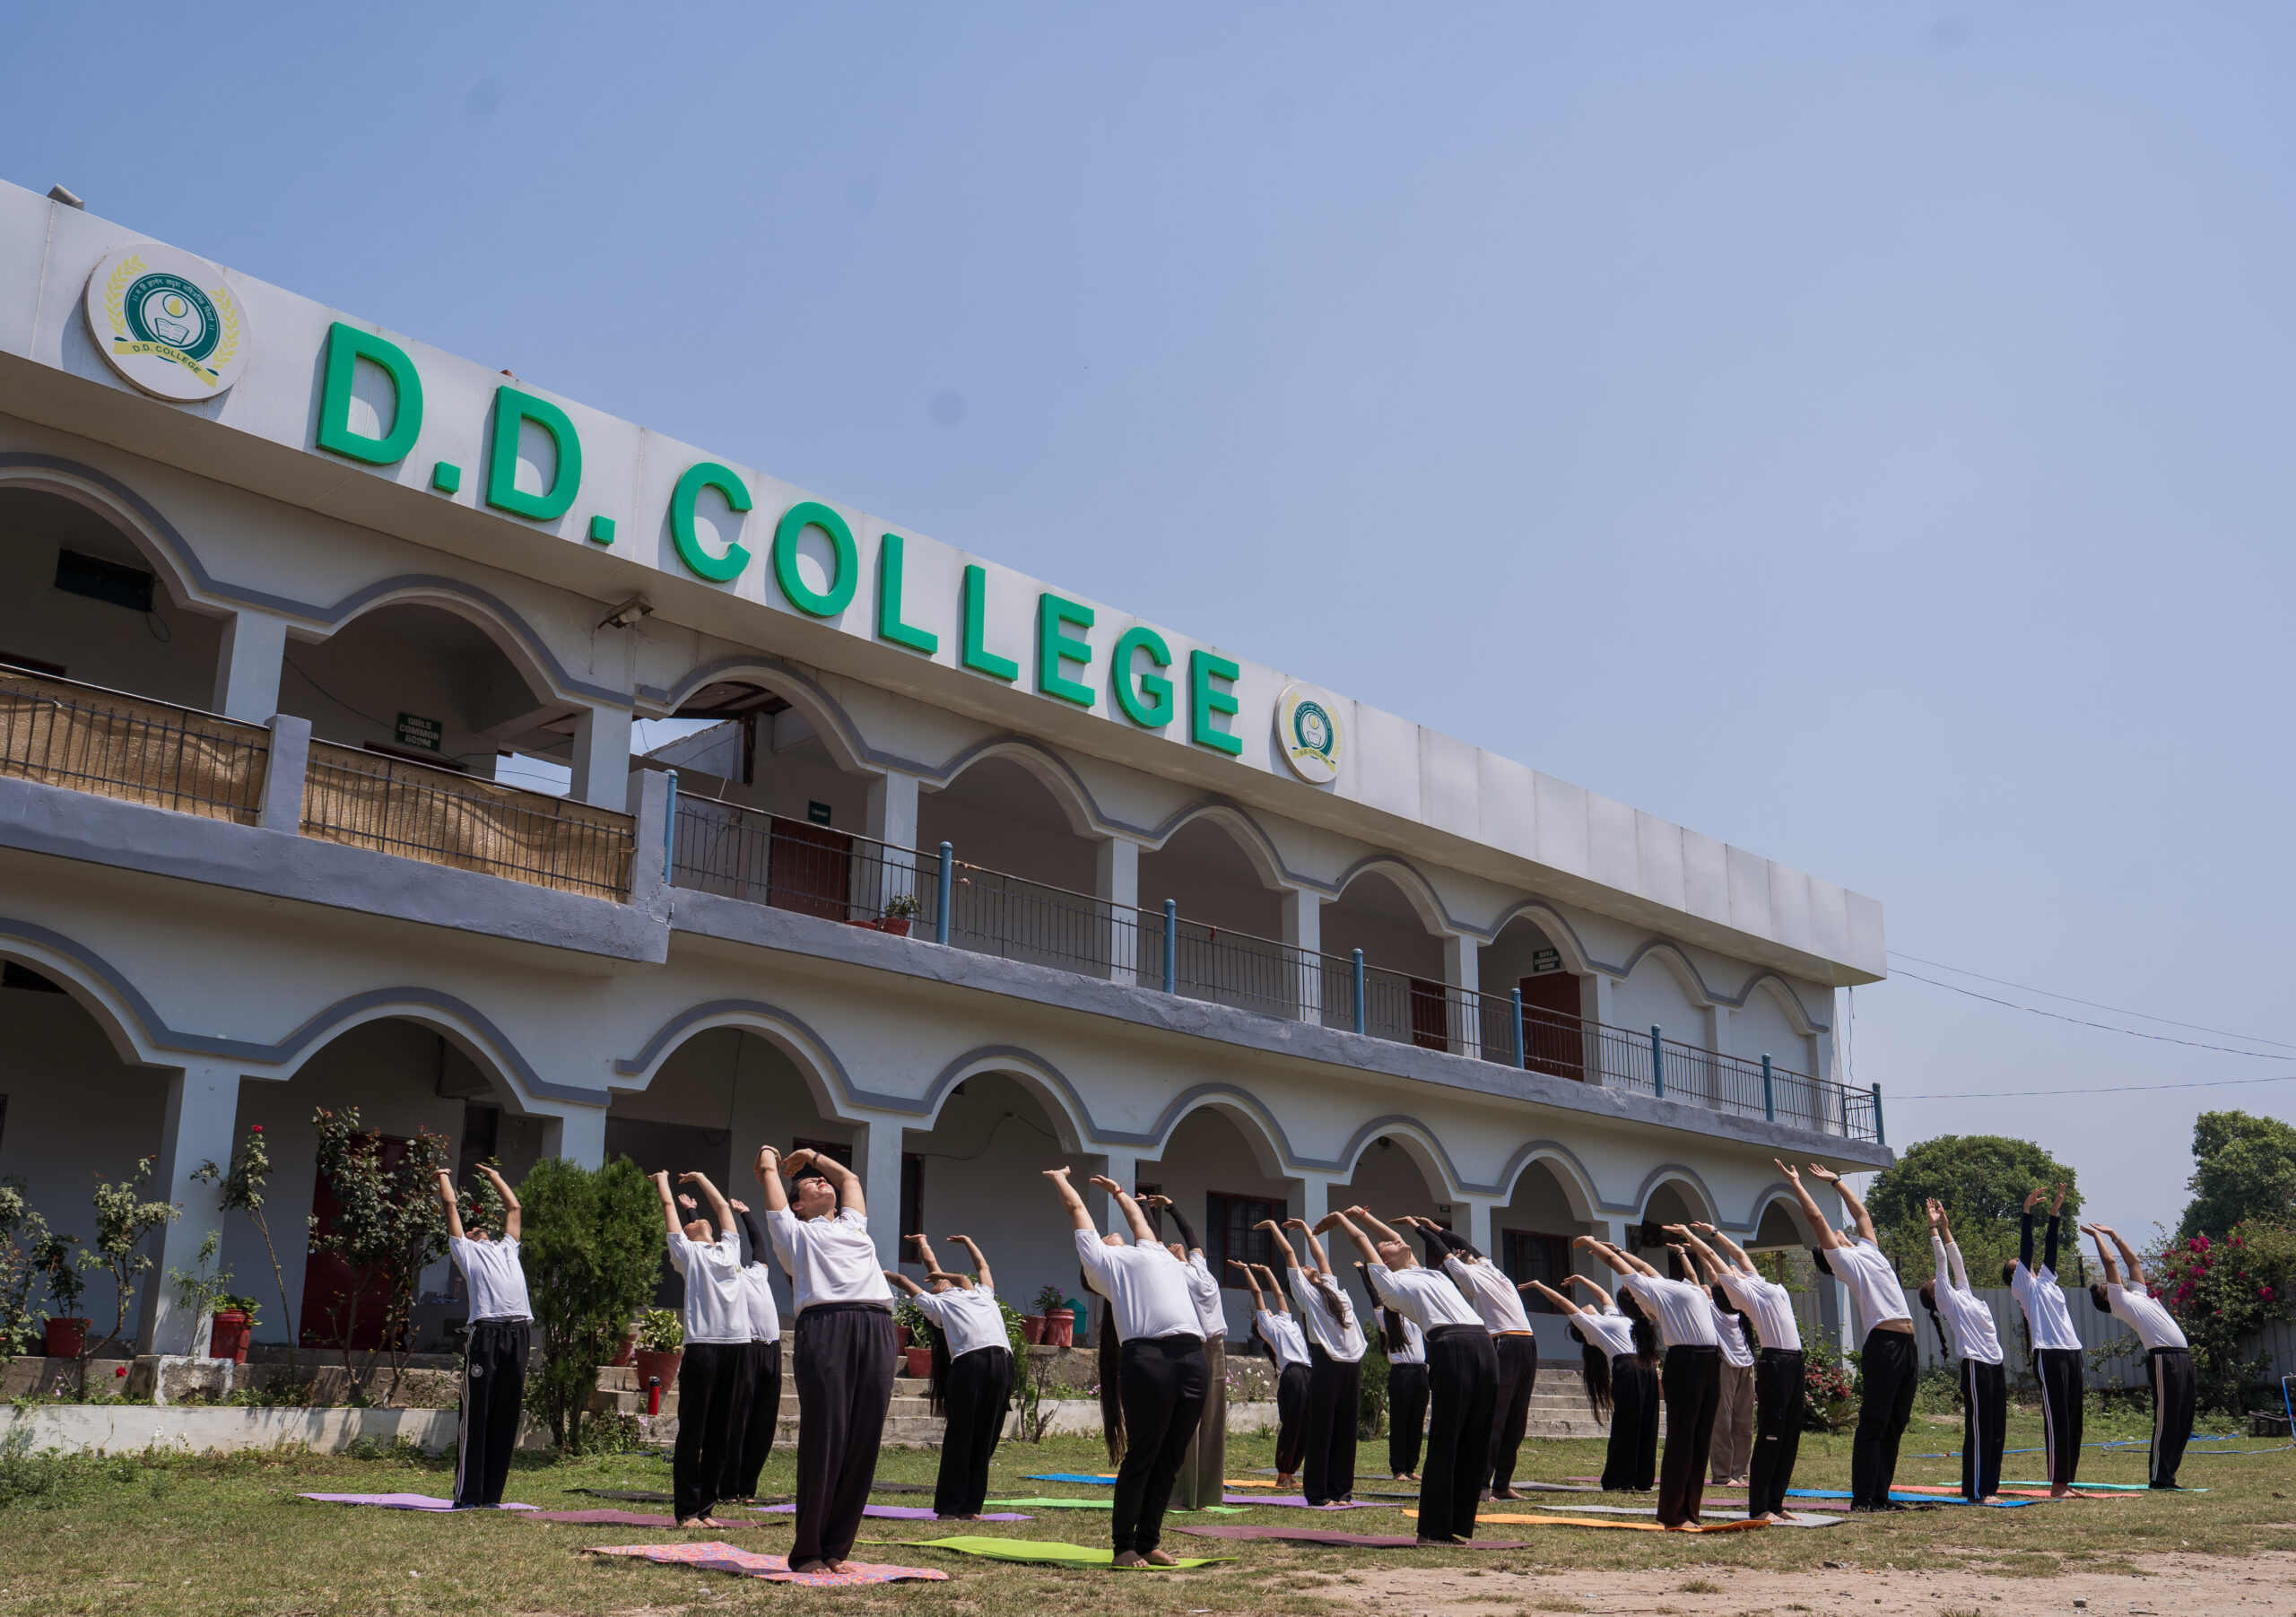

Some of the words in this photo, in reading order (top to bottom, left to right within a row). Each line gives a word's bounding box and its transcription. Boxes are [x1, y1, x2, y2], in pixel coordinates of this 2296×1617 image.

[132, 343, 152, 352] D.D.
[155, 345, 201, 373] COLLEGE
[316, 322, 615, 544] D.D.
[670, 463, 1242, 755] COLLEGE
[407, 717, 432, 730] GIRLS
[398, 724, 439, 741] COMMON
[404, 734, 431, 748] ROOM
